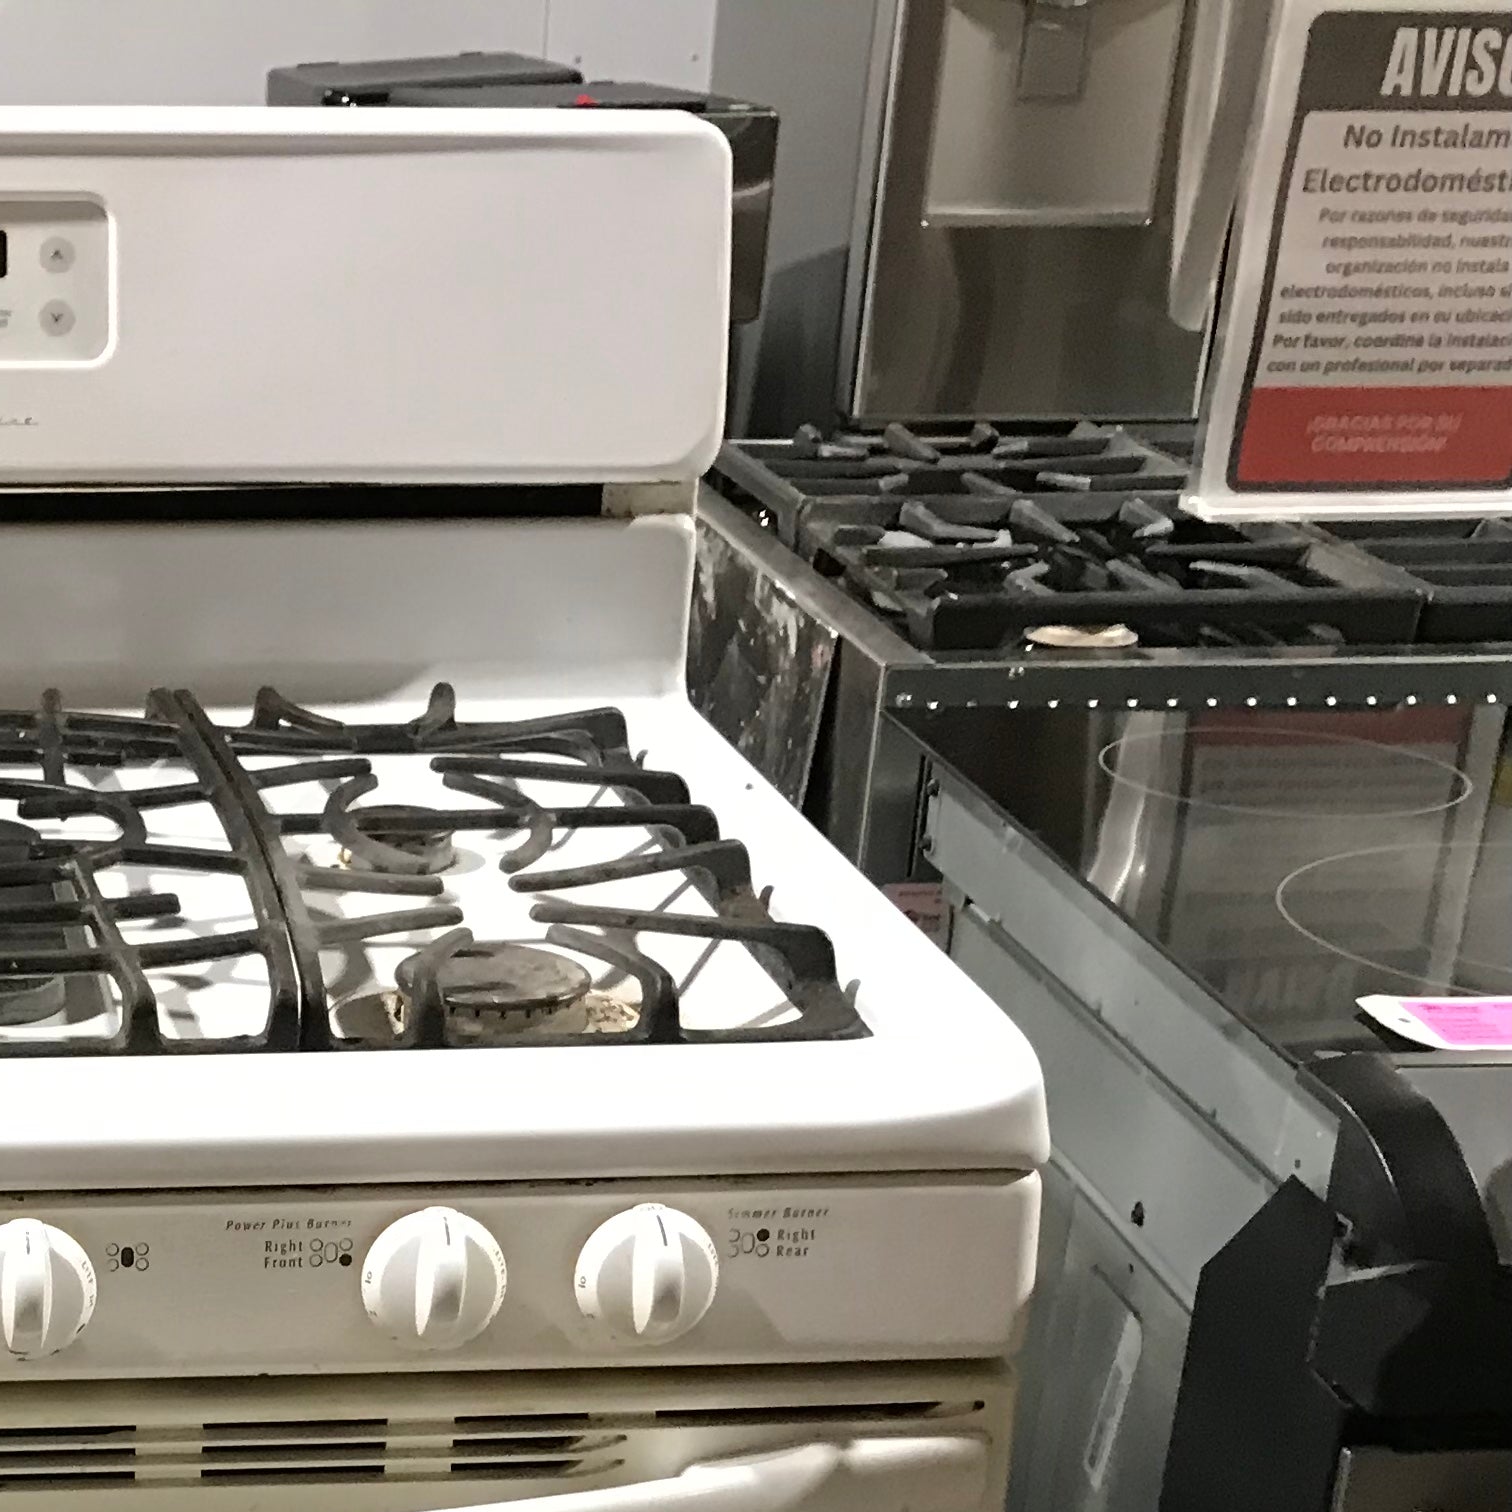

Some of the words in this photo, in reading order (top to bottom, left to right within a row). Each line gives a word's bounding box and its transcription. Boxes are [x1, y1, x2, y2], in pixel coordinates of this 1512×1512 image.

[1343, 124, 1383, 148] No
[1319, 208, 1346, 223] Por
[1417, 209, 1437, 223] de
[1432, 261, 1452, 273] no
[1273, 334, 1301, 348] Por
[1266, 360, 1296, 372] con
[1300, 361, 1320, 372] un
[1417, 360, 1444, 373] por
[225, 1219, 266, 1231] Power
[777, 1228, 815, 1243] Right
[264, 1240, 303, 1255] Right
[776, 1245, 808, 1257] Rear
[264, 1256, 303, 1269] Front
